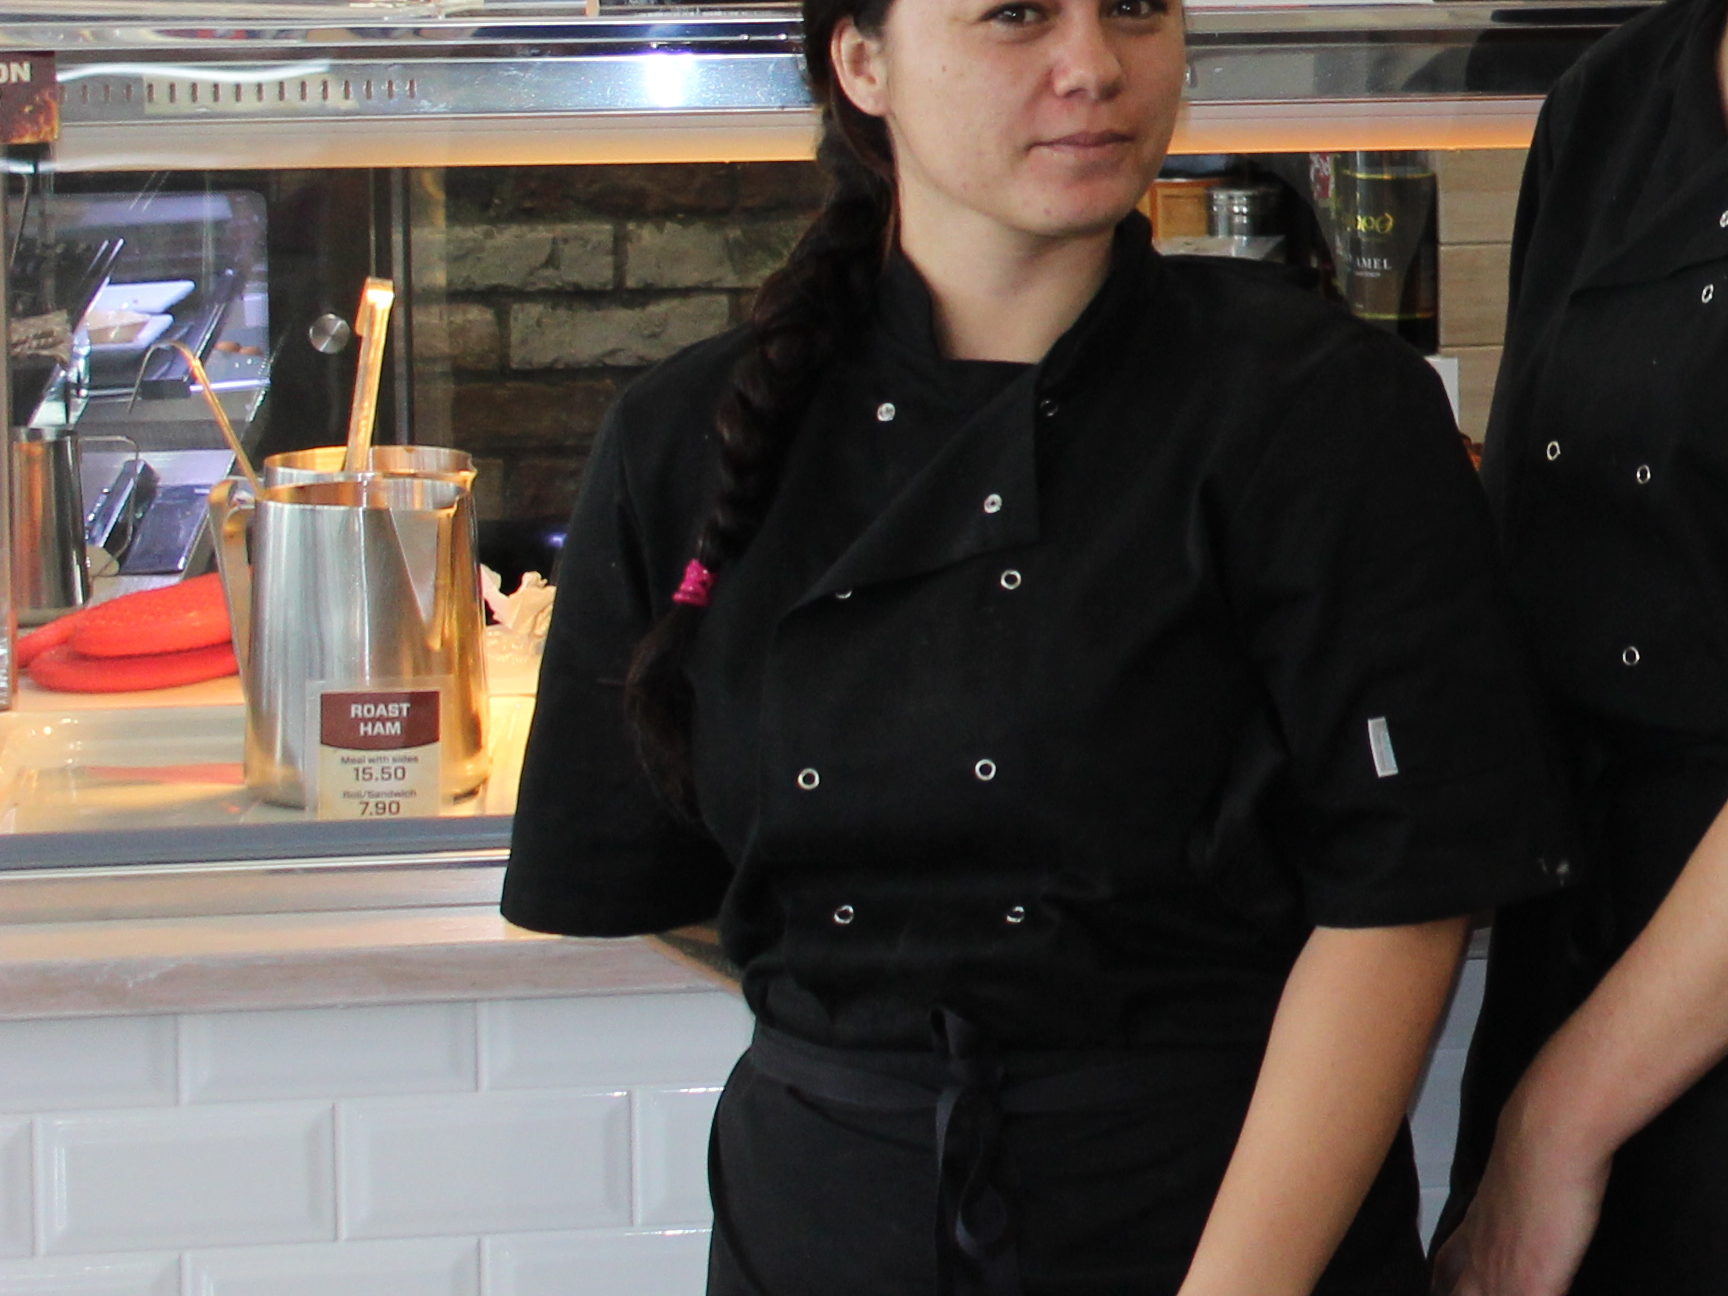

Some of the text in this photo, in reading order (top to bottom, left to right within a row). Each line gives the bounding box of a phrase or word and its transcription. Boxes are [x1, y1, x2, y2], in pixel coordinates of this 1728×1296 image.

[351, 703, 411, 719] ROAST
[360, 721, 401, 736] HAM
[340, 756, 366, 765] Meal
[353, 765, 406, 781] 15.50
